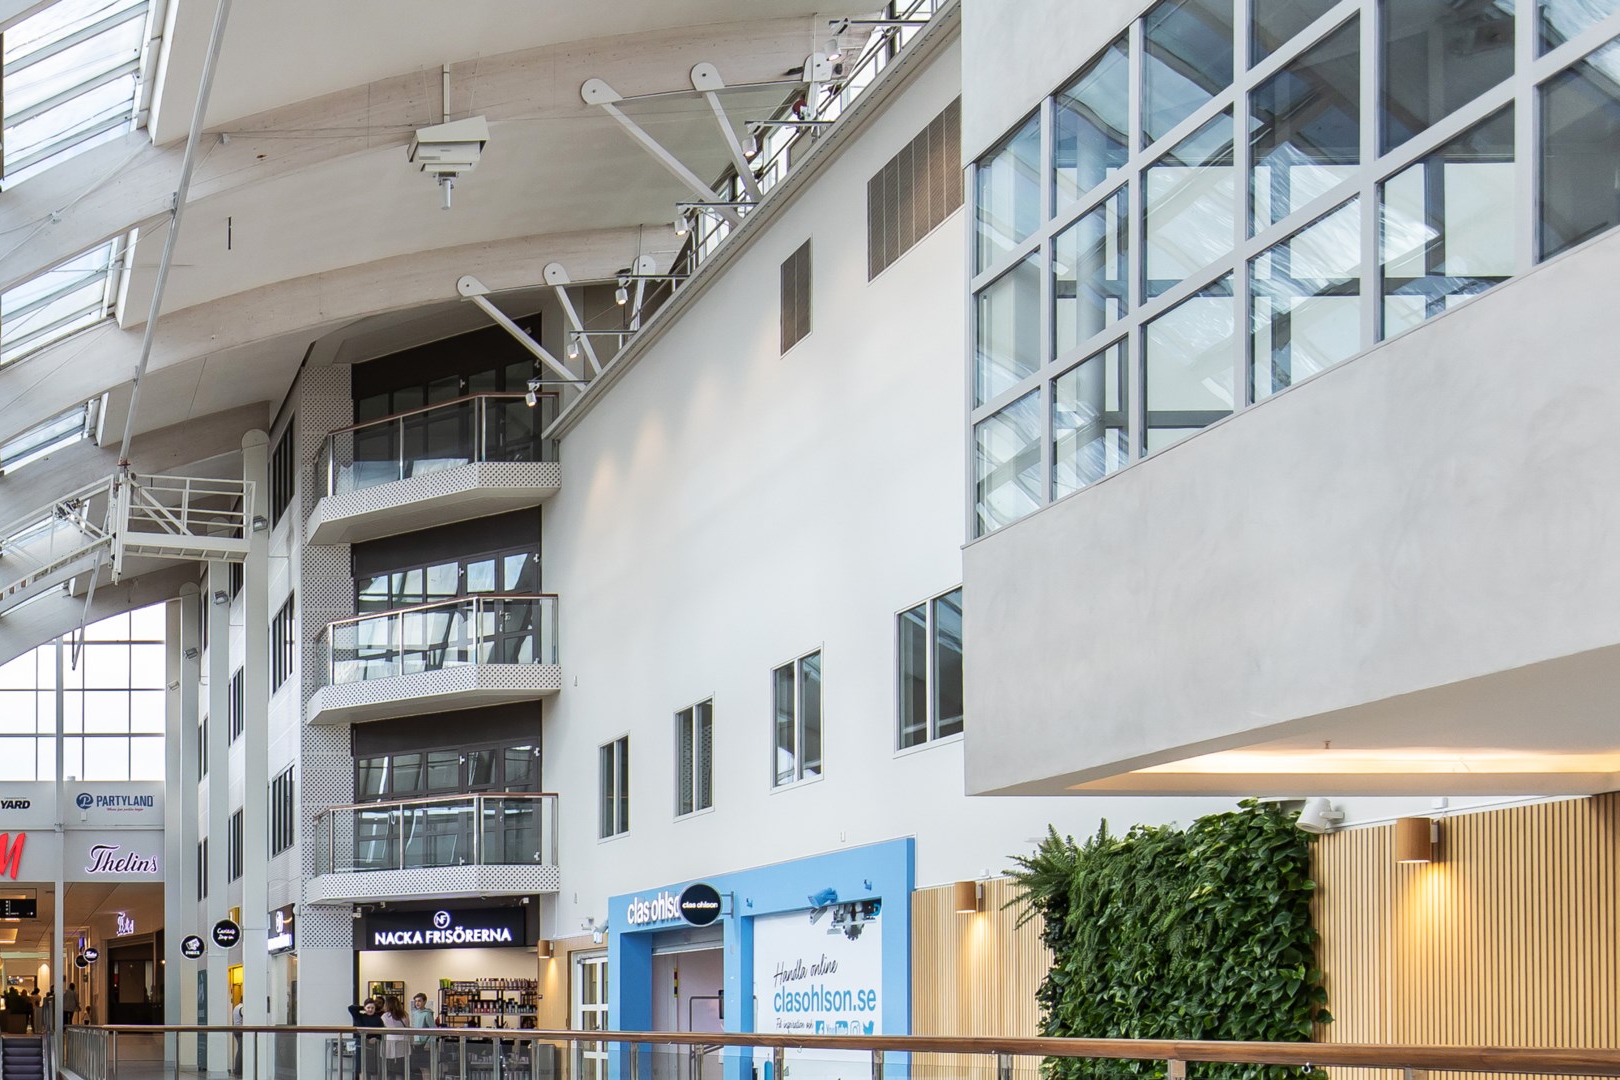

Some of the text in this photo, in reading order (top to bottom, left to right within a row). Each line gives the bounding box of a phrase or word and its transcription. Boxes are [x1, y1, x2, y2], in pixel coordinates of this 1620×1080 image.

[0, 799, 31, 810] YARD
[96, 794, 154, 807] PARTYLAND
[85, 844, 158, 873] Thelins
[627, 895, 650, 924] clas
[682, 901, 718, 909] clas ohlson
[374, 926, 512, 945] NACKA FRISÖRERNA
[774, 953, 839, 988] Handla online
[774, 984, 877, 1013] clasohlson.se
